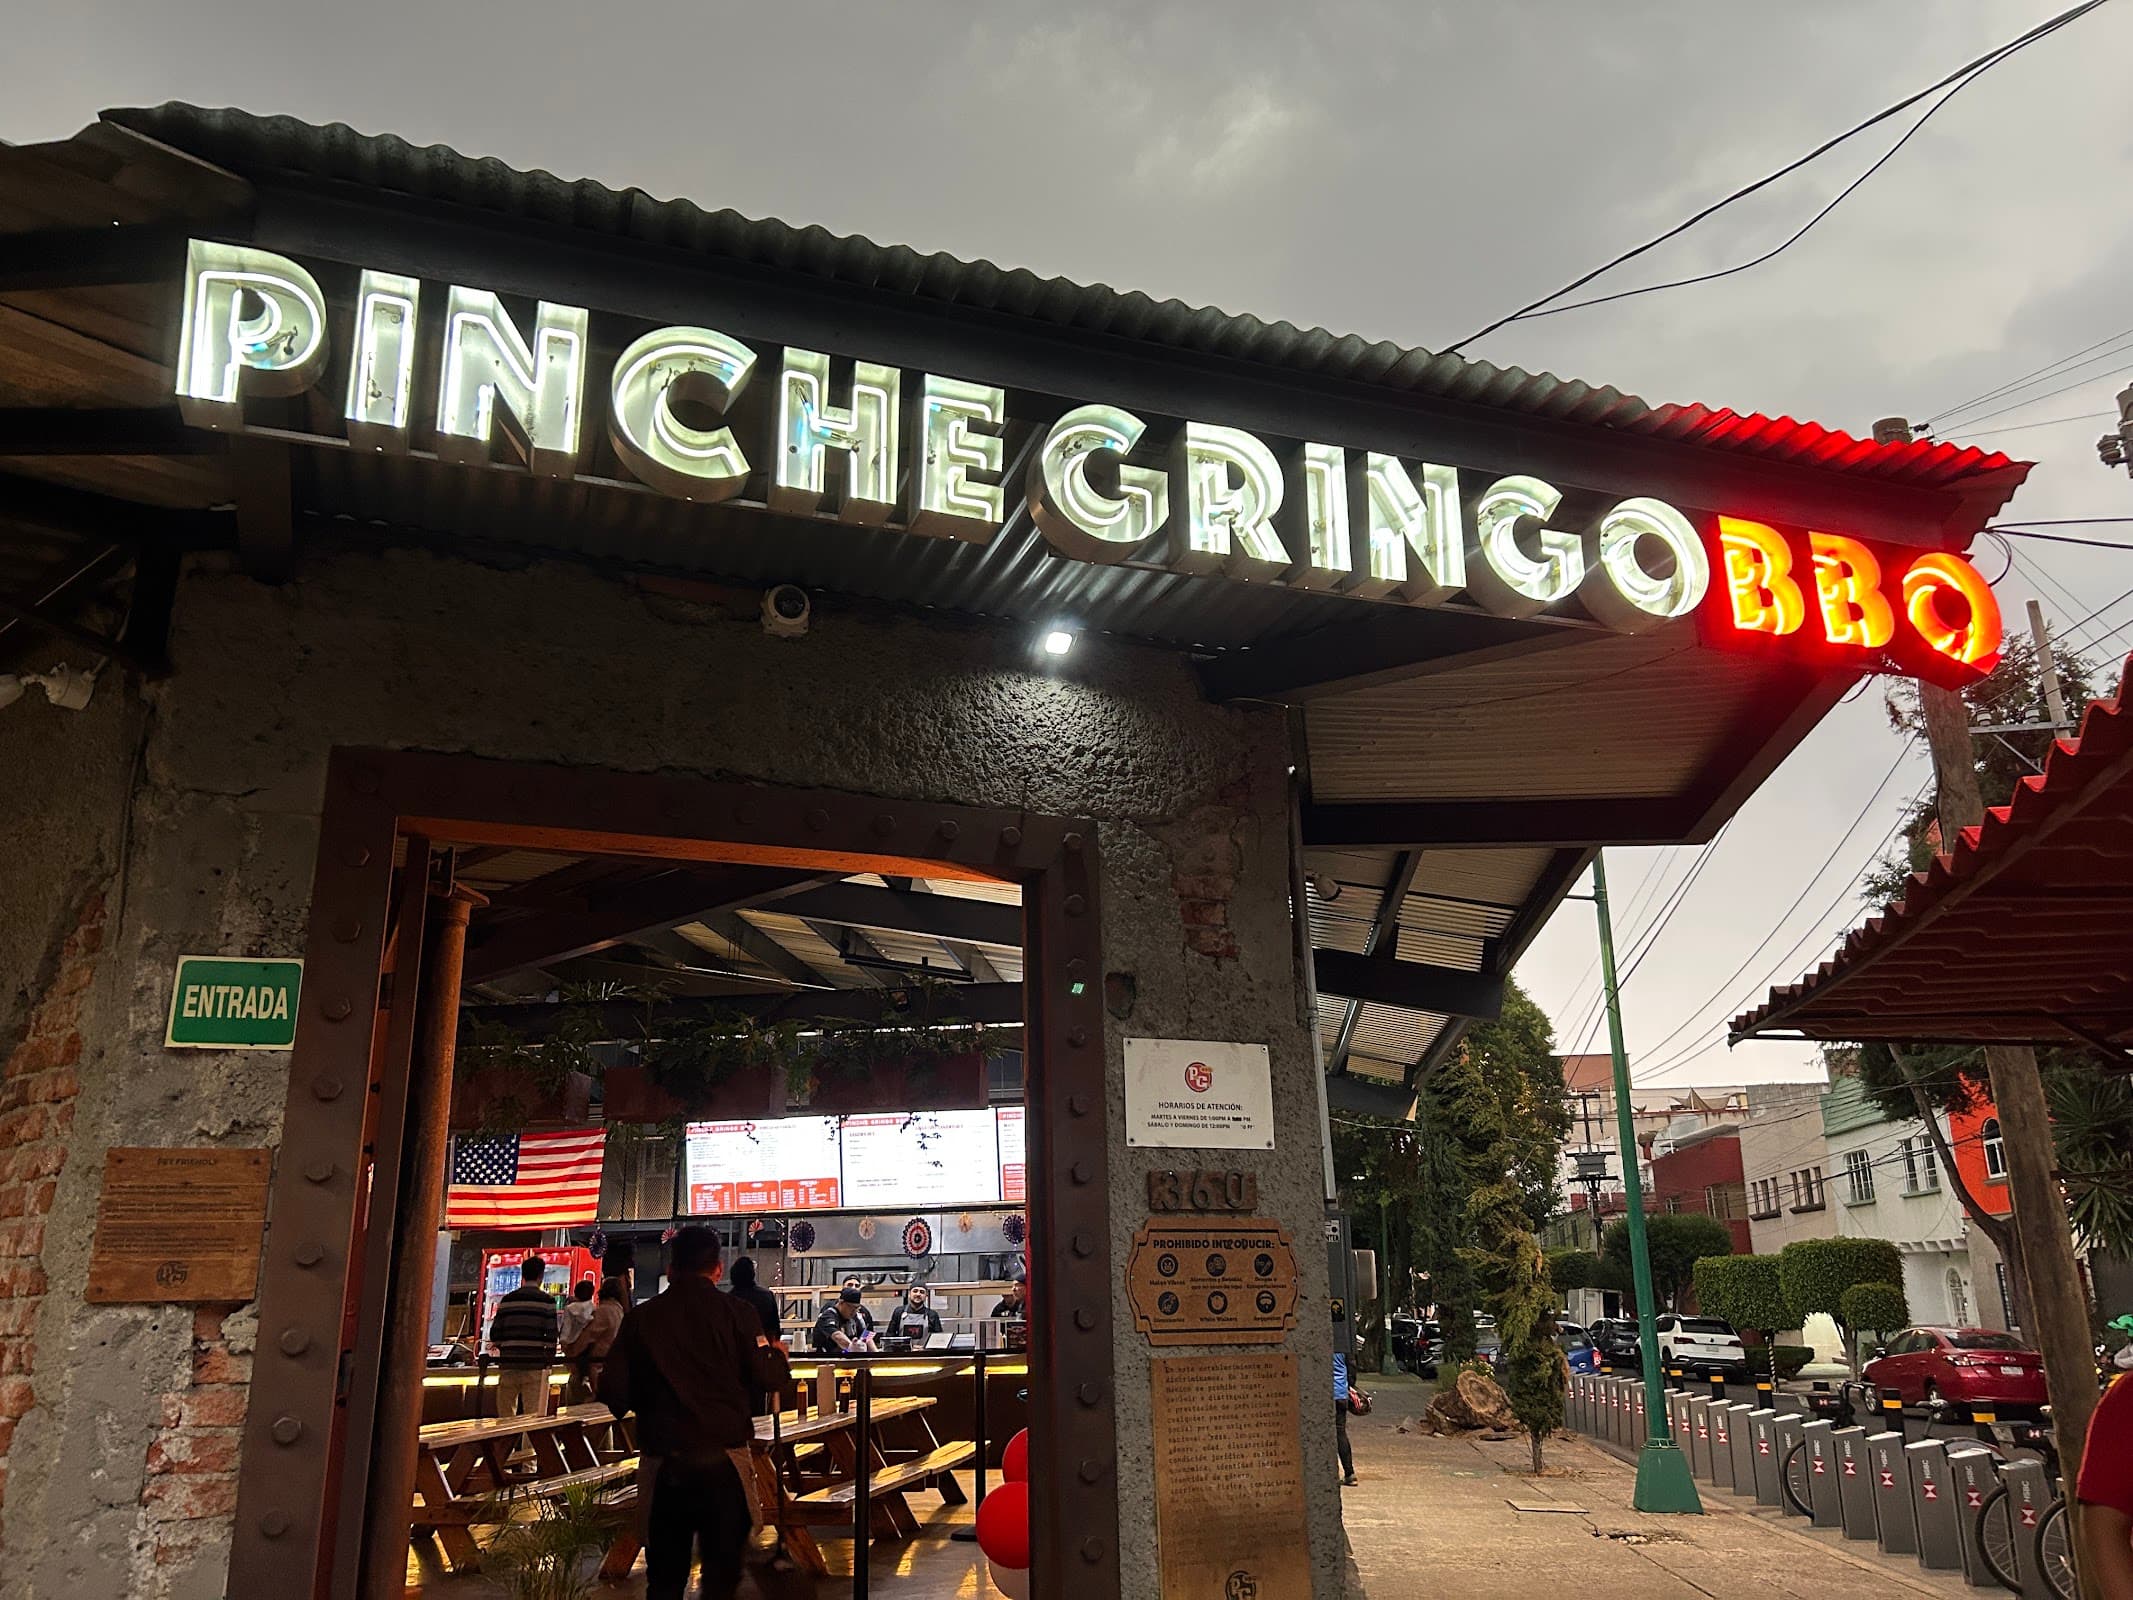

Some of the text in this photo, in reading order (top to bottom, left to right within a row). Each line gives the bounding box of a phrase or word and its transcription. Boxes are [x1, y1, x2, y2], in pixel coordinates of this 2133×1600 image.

[176, 238, 2004, 675] PINCHE GRINGO BBQ
[182, 984, 288, 1020] ENTRADA
[1158, 1102, 1195, 1110] HORARIOS
[1207, 1102, 1244, 1111] ATENCIÓN:
[1162, 1168, 1245, 1210] 360
[1154, 1238, 1275, 1250] PROHIBIDO INTRODUCIR:
[2021, 1480, 2031, 1502] HSBC
